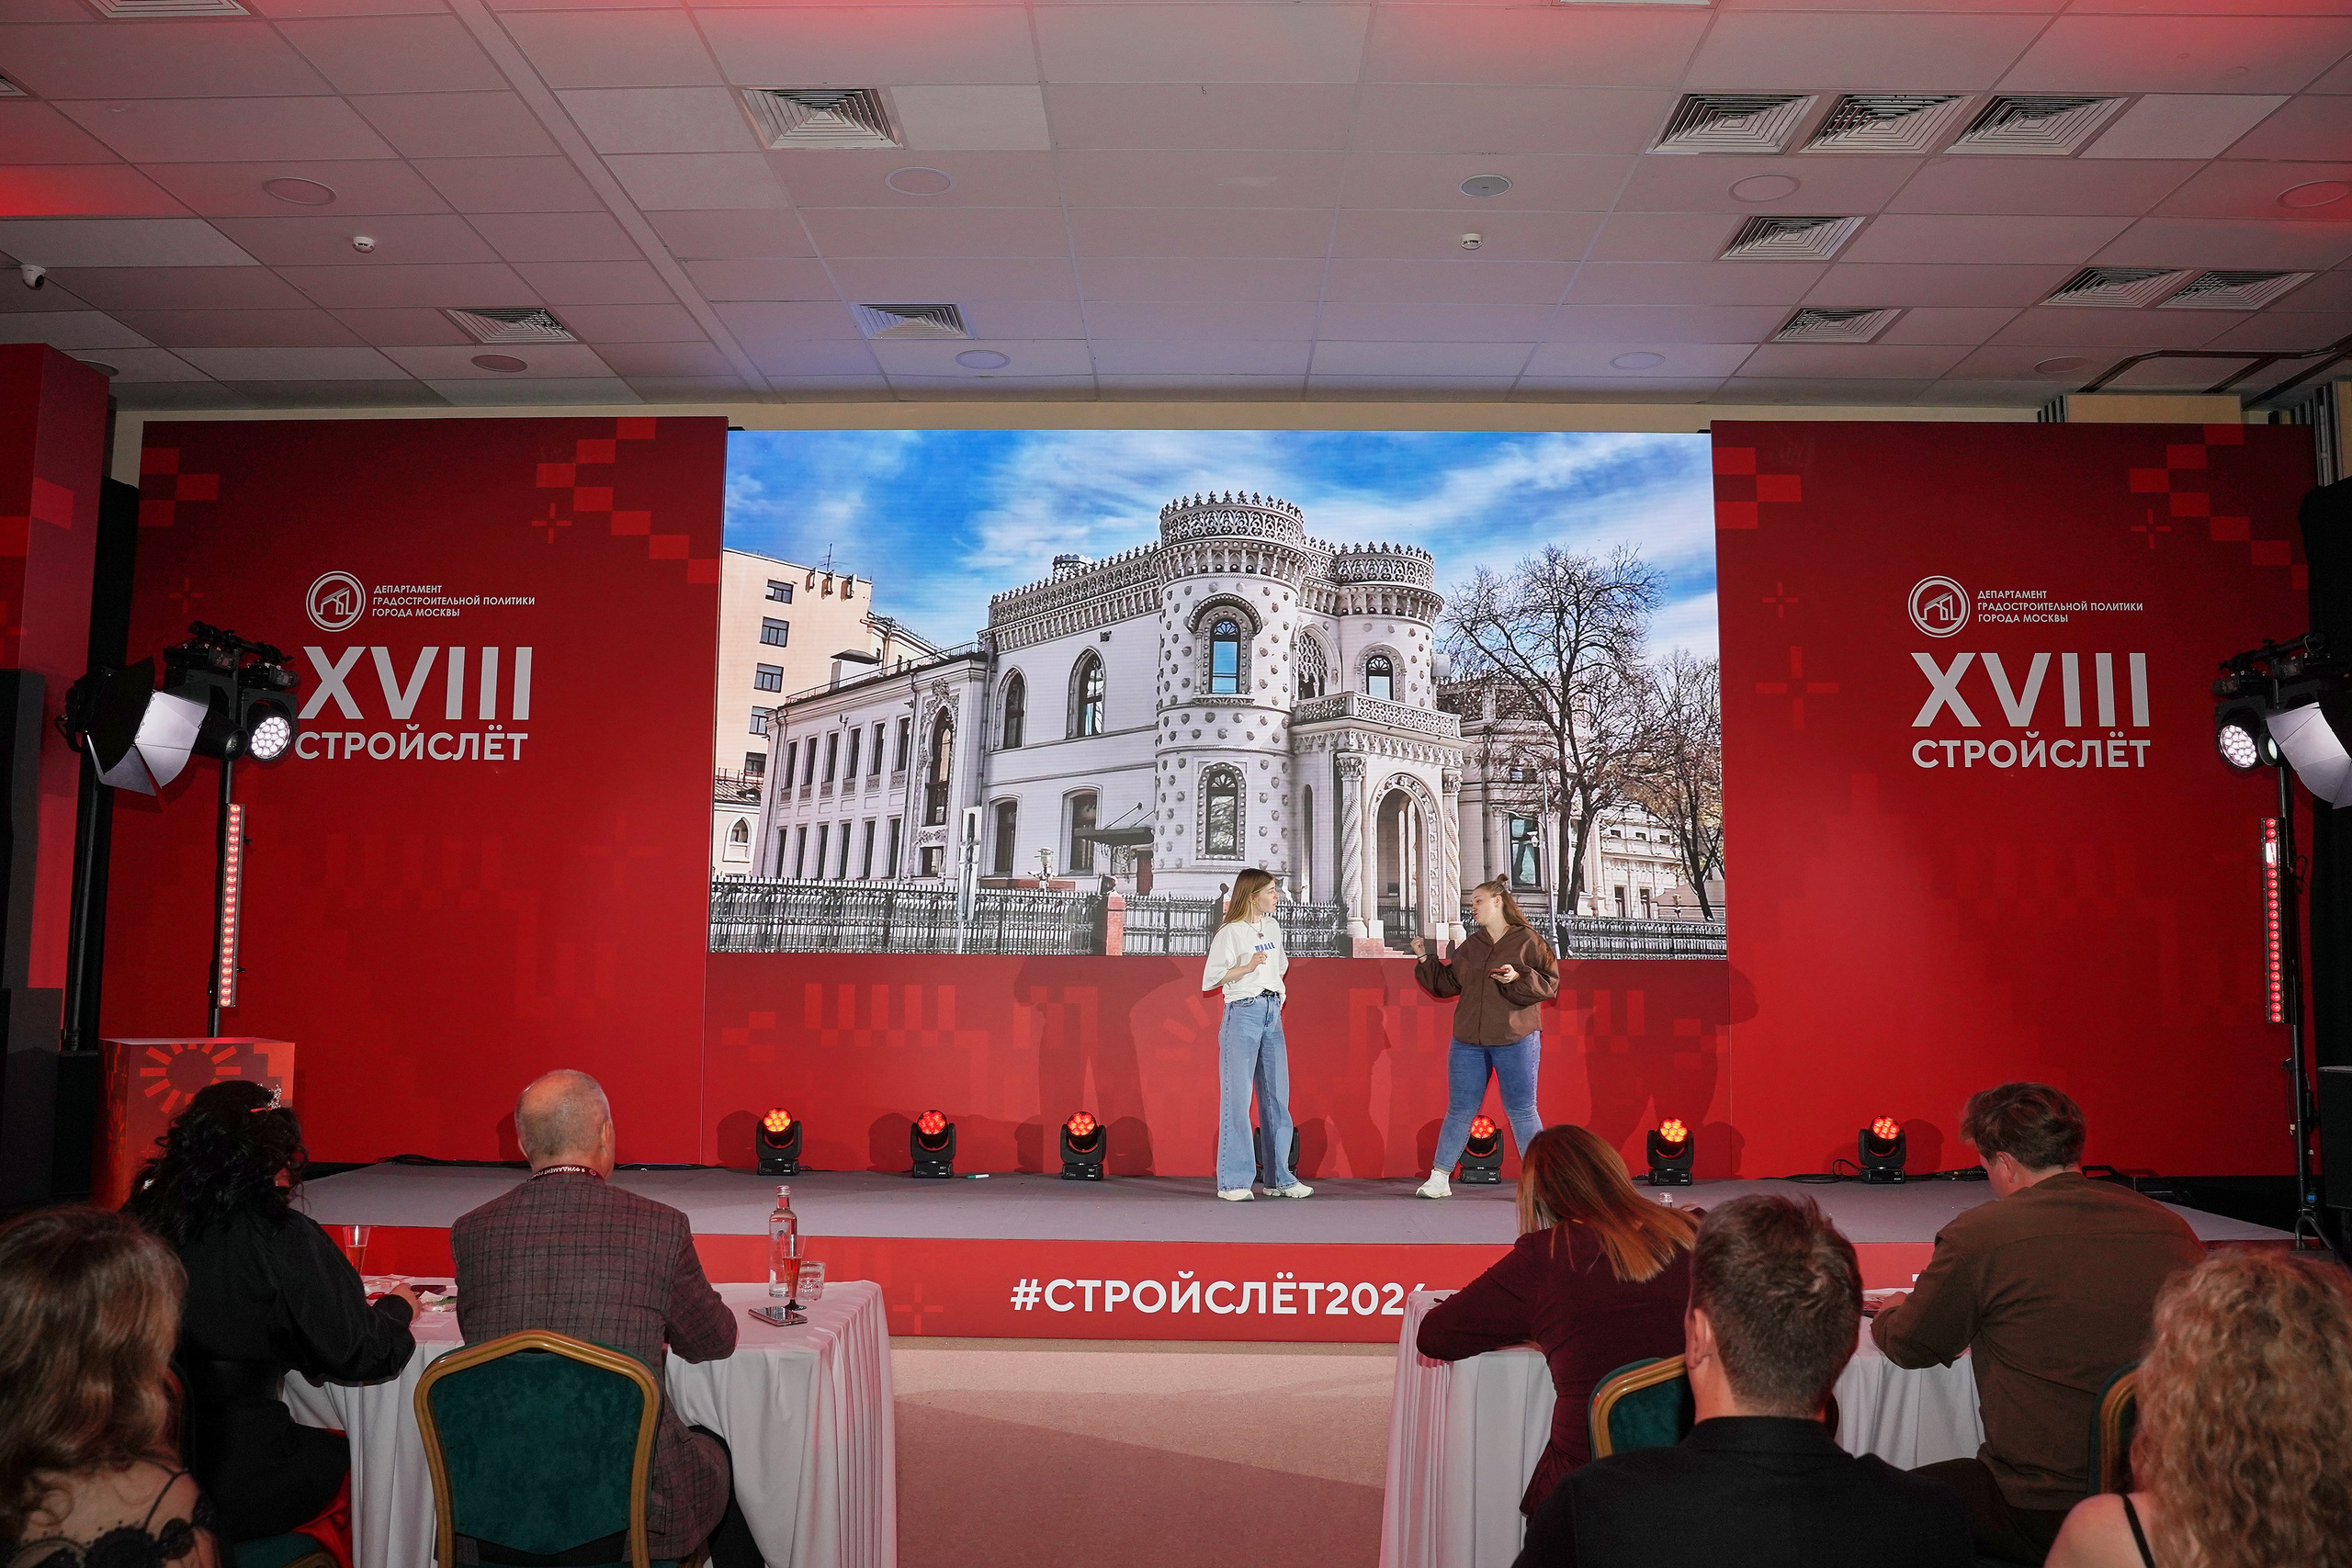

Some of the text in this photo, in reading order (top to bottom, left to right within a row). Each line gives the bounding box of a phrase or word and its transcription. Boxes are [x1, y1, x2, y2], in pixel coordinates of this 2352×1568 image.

[374, 585, 442, 594] ДЕПАРТАМЕНТ
[1977, 590, 2047, 600] ДЕПАРТАМЕНТ
[373, 595, 536, 606] ГРАДОСТРОИТЕЛЬНОЙ ПОЛИТИКИ
[1977, 601, 2143, 612] ГРАДОСТРОИТЕЛЬНОЙ ПОЛИТИКИ
[372, 608, 460, 617] ГОРОДА МОСКВЫ
[1978, 614, 2068, 623] ГОРОДА МОСКВЫ
[298, 646, 533, 720] XVIII
[1910, 652, 2150, 728] XVIII
[295, 723, 528, 761] СТРОЙСЛЁТ
[1912, 731, 2151, 768] СТРОЙСЛЁТ
[1010, 1270, 1426, 1315] #СТРОЙСЛЁТ202
